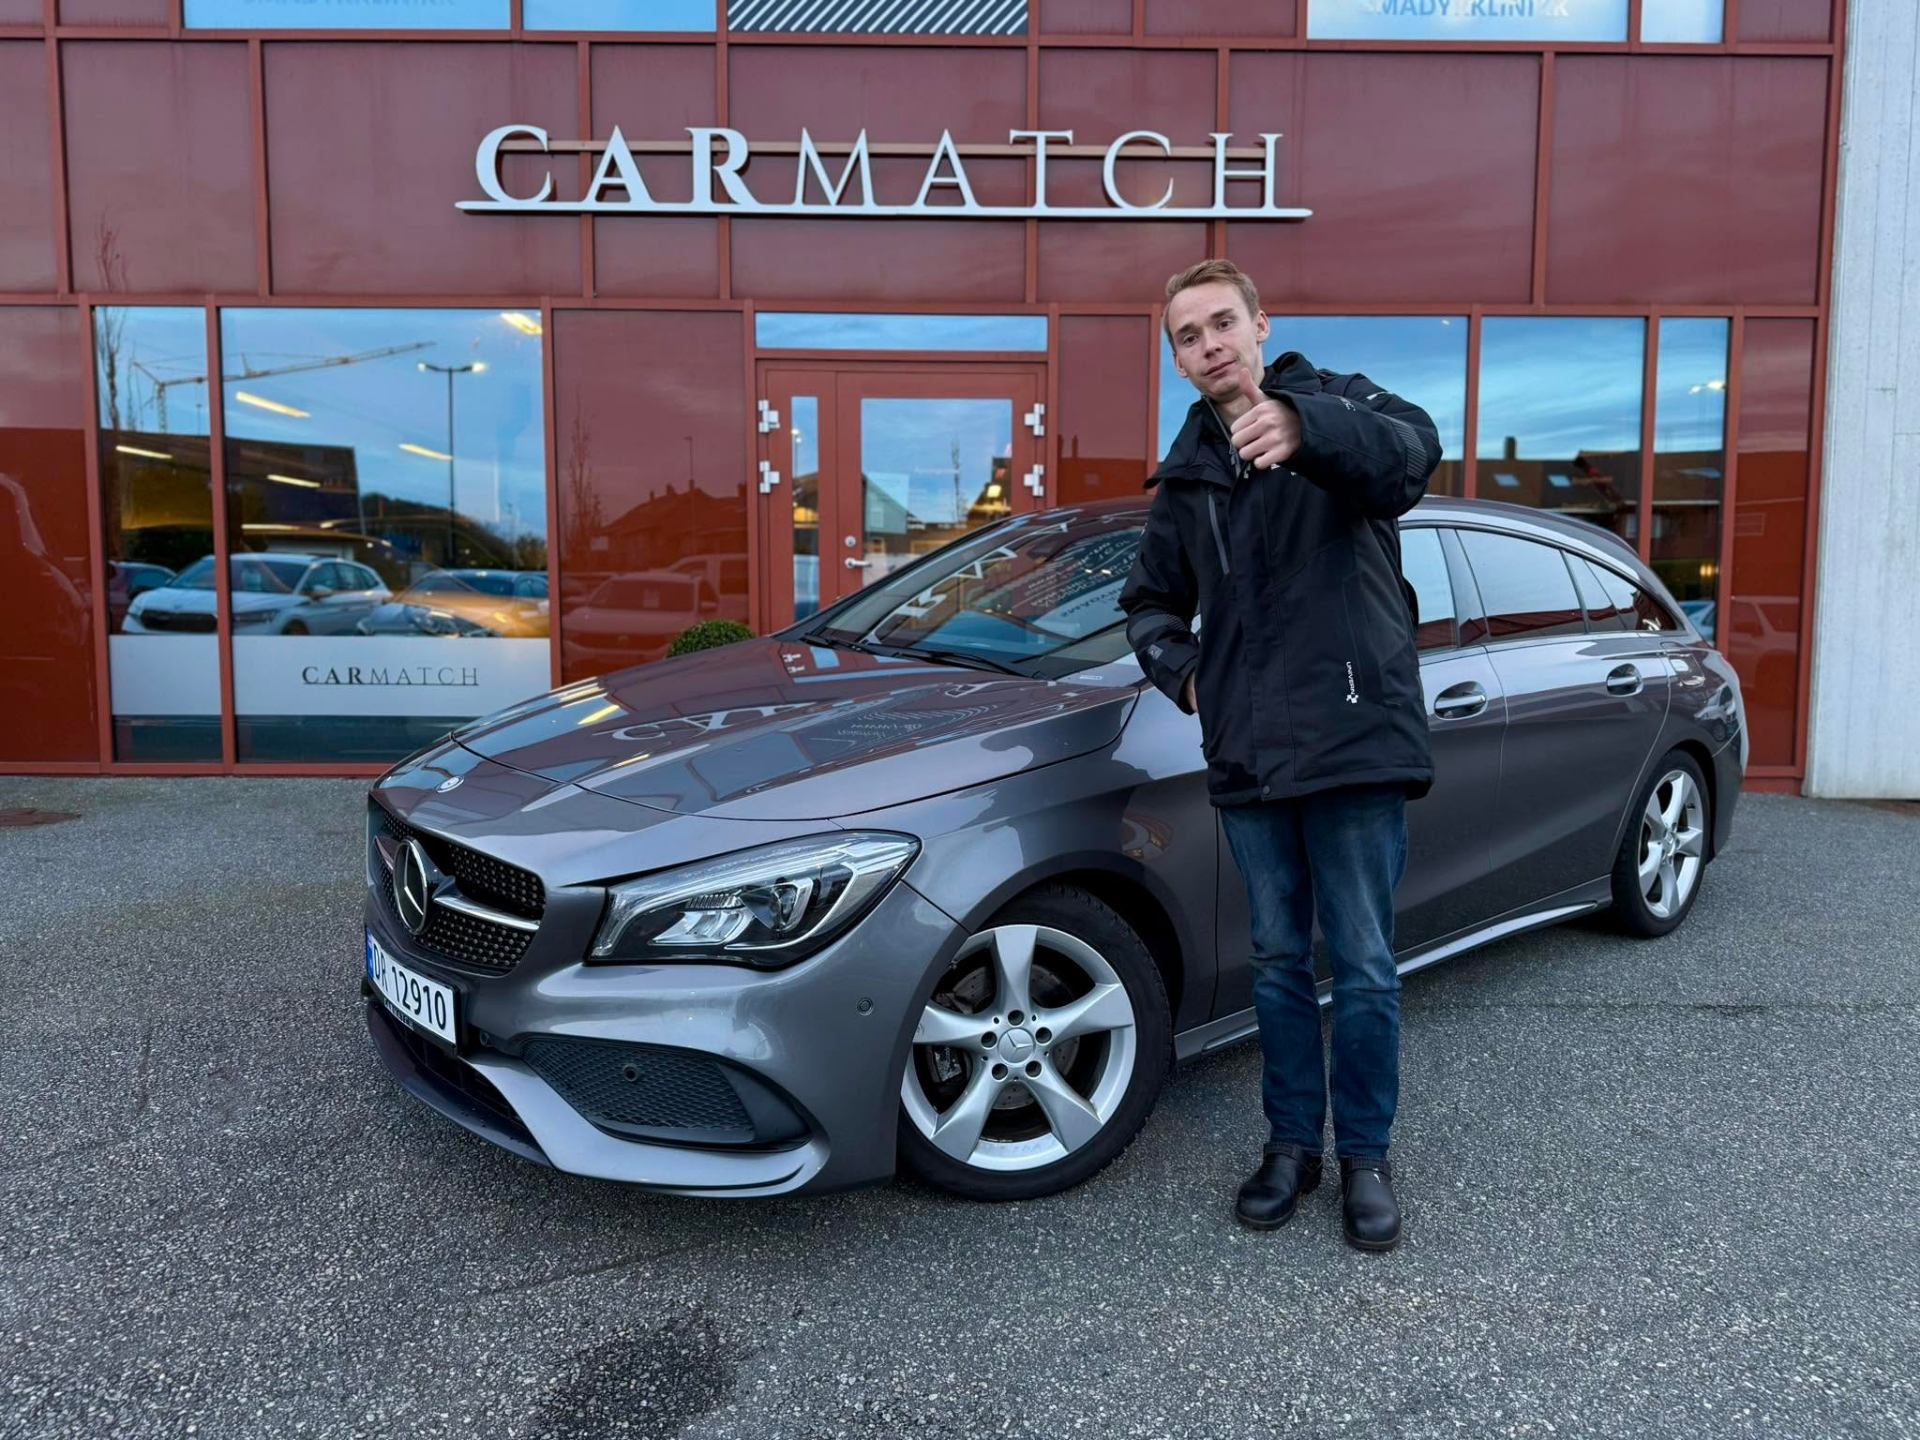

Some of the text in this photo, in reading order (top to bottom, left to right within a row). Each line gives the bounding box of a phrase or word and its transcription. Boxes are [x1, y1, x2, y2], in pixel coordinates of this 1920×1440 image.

[474, 123, 1286, 214] CARMATCH
[301, 665, 480, 686] CARMATCH
[373, 943, 389, 992] DR
[391, 966, 447, 1031] 12910
